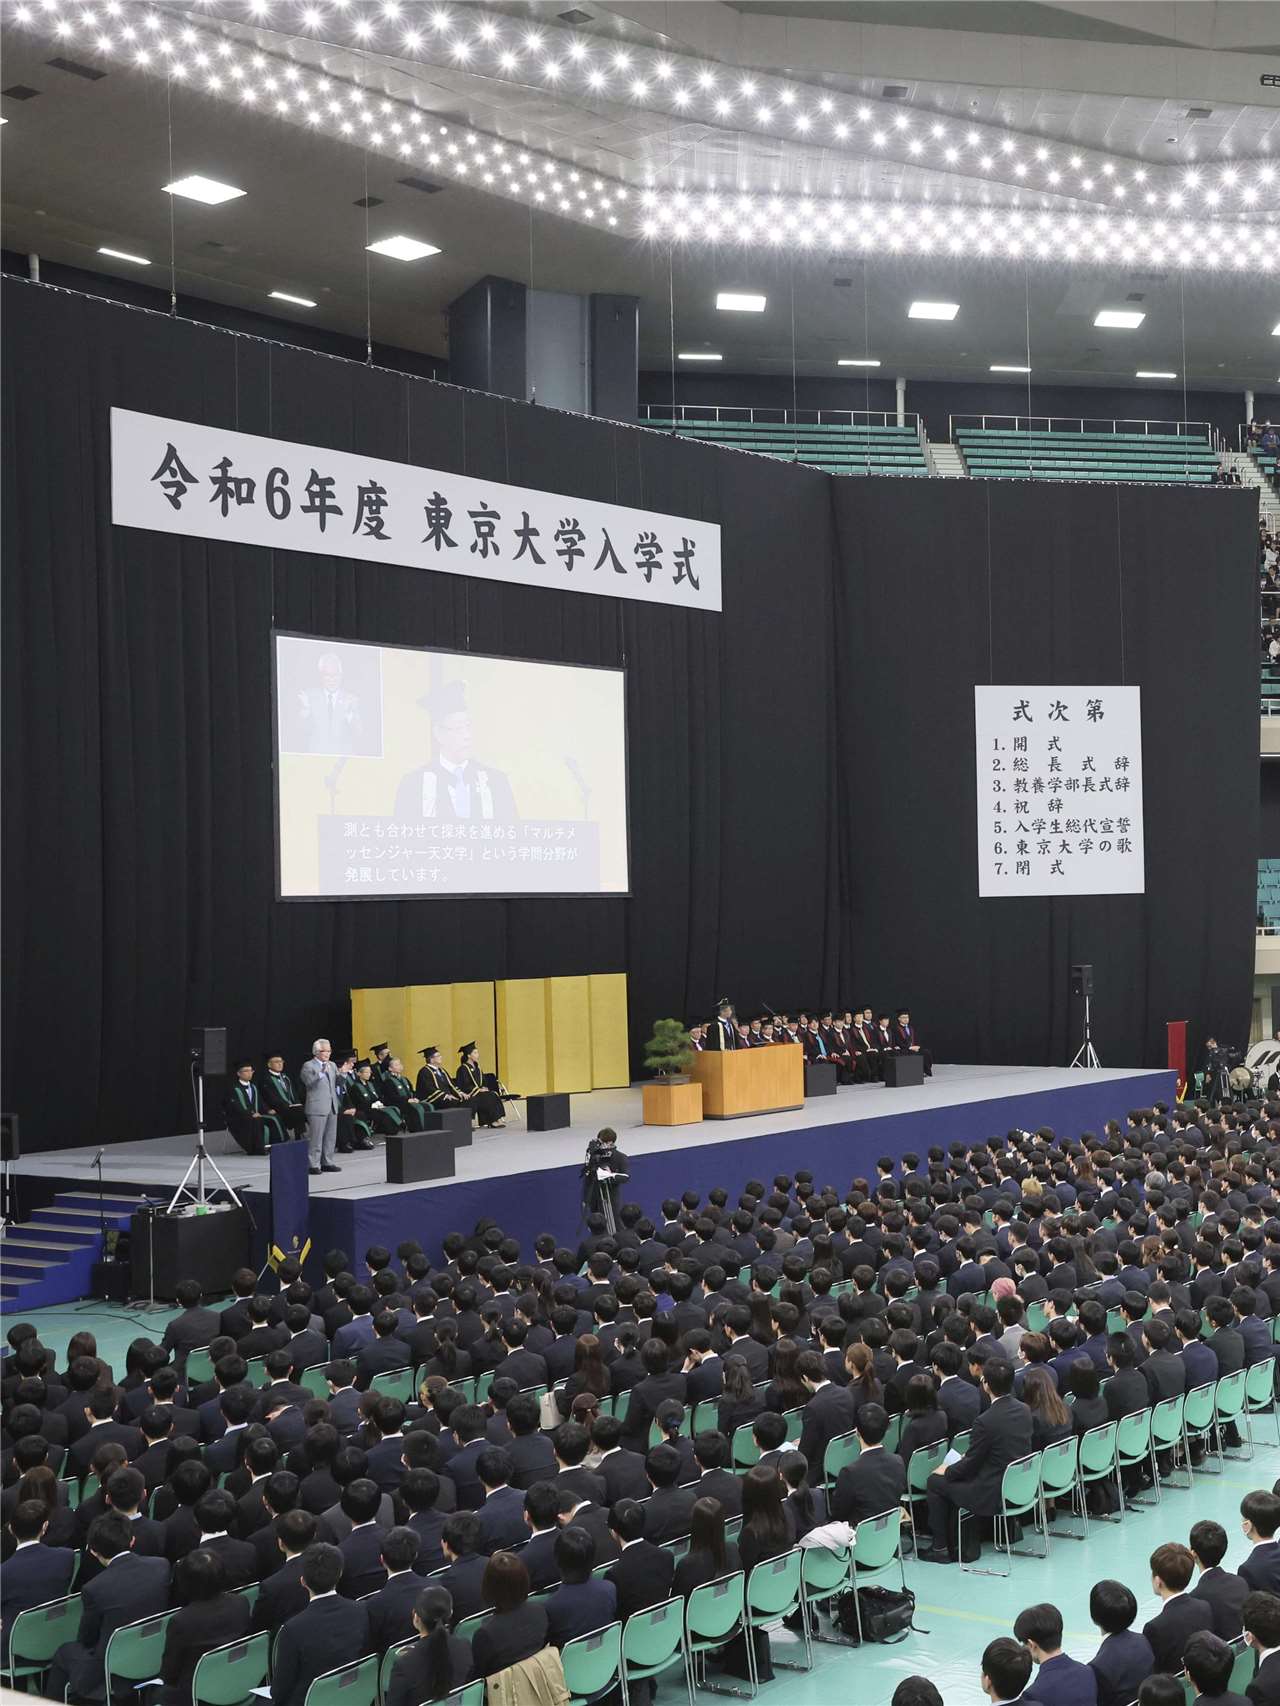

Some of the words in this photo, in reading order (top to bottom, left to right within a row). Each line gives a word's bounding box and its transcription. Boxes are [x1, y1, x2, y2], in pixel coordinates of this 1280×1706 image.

[150, 442, 392, 541] 令和6年度
[421, 490, 700, 591] 東京大学入学式
